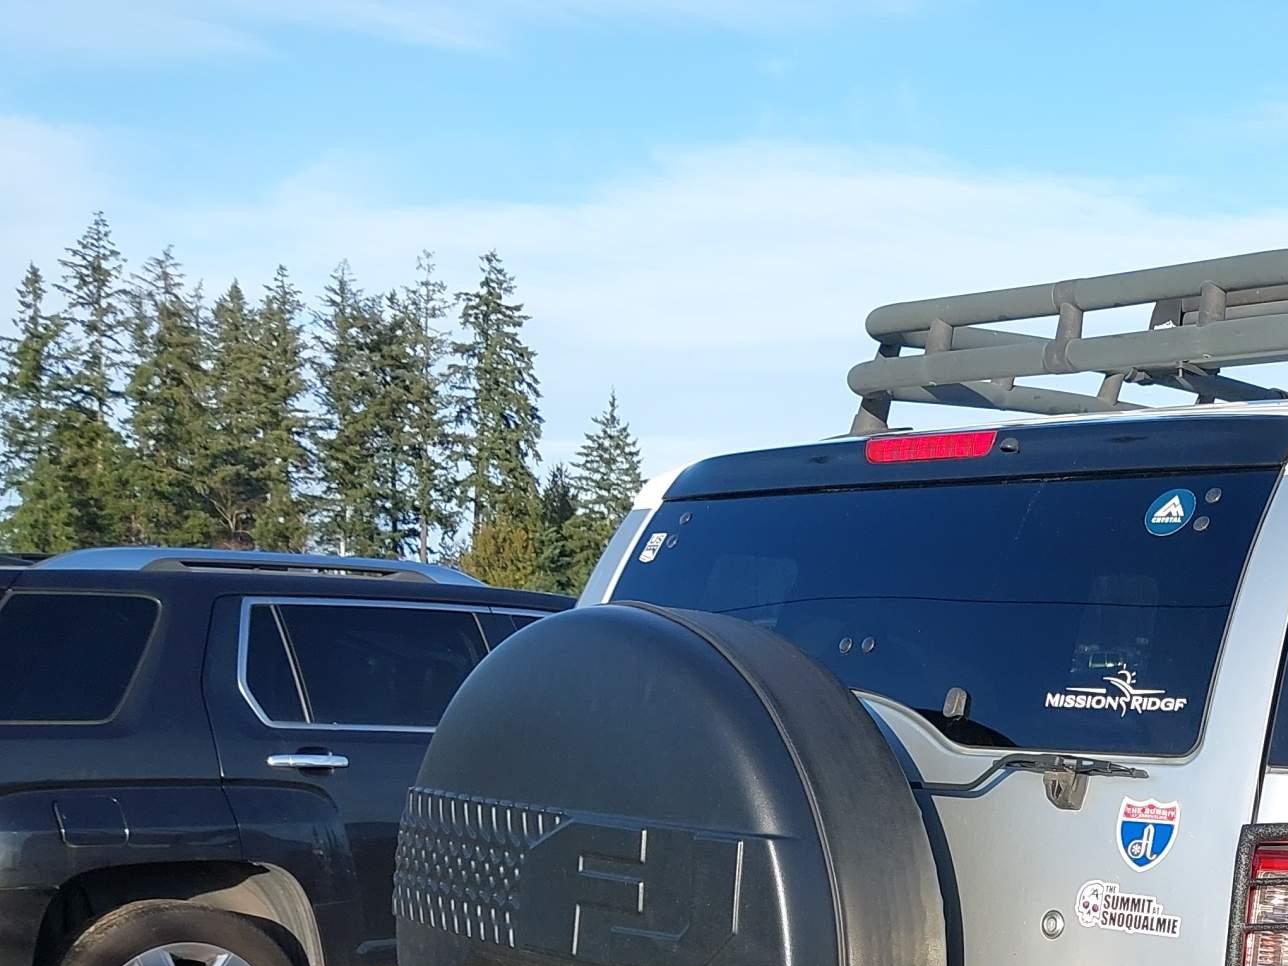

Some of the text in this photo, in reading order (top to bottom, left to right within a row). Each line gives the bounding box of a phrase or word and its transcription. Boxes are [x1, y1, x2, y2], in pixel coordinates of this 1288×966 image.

[1151, 516, 1182, 524] CRYSTAL
[1044, 692, 1120, 711] MISSION
[1106, 885, 1117, 894] THE
[1103, 894, 1153, 914] SUMMIT
[1101, 911, 1179, 935] SNOQUALMIE
